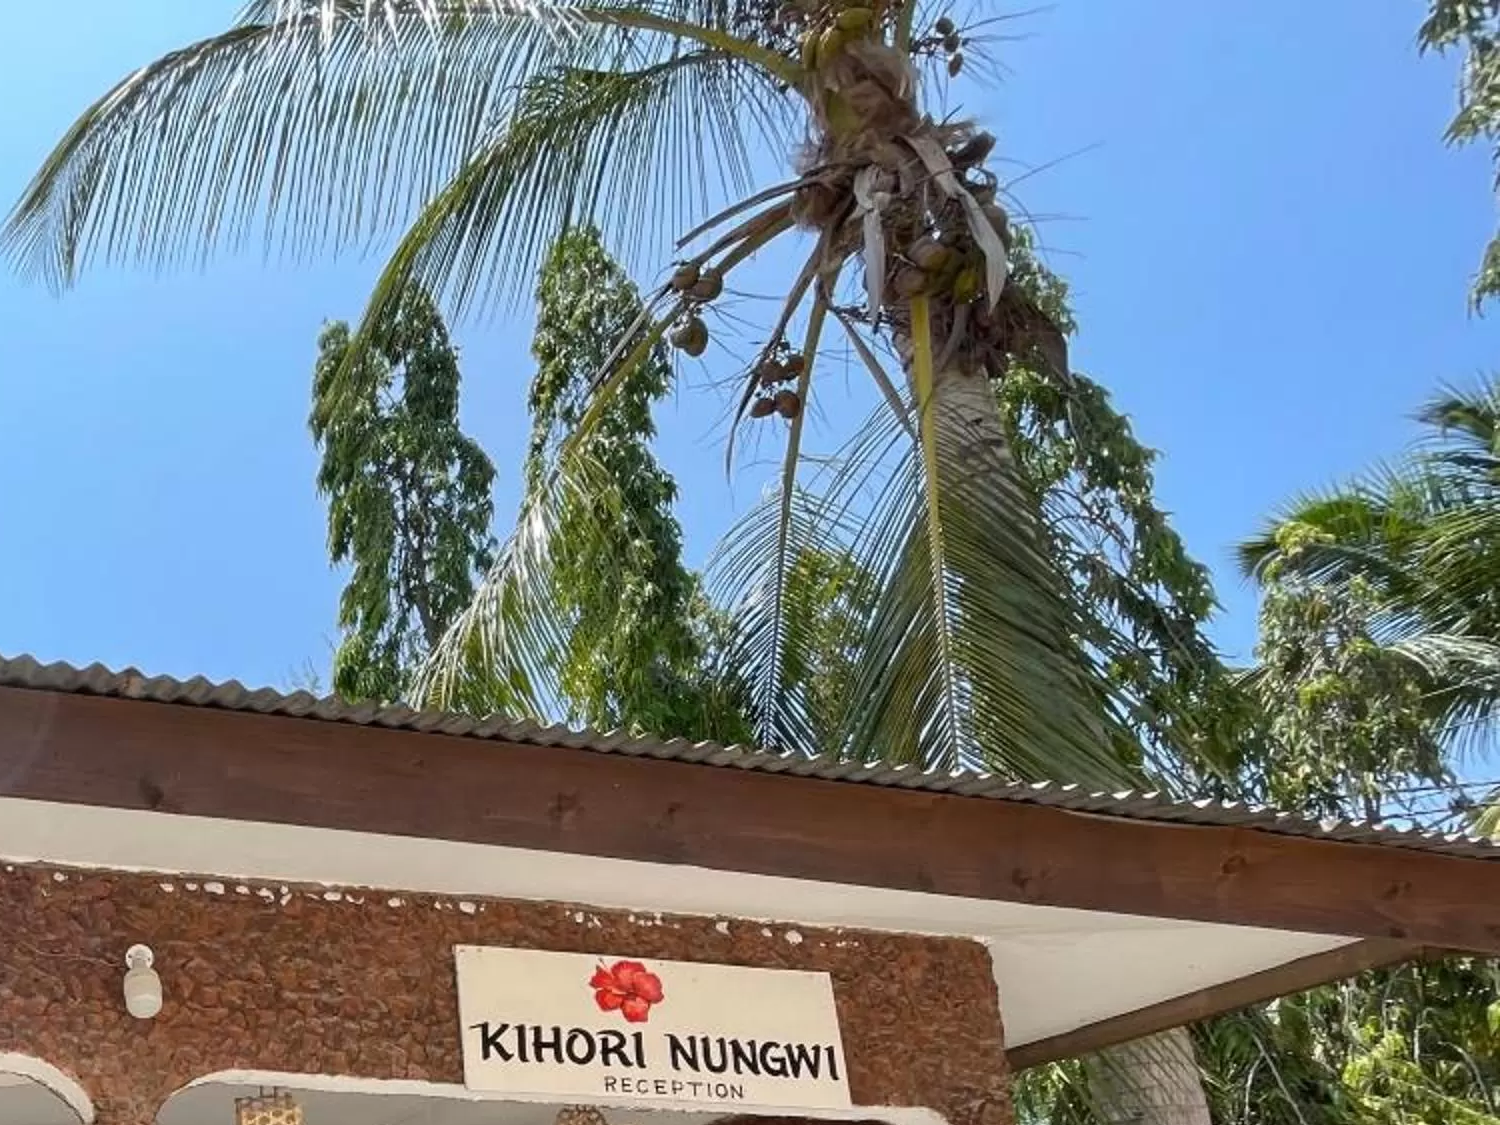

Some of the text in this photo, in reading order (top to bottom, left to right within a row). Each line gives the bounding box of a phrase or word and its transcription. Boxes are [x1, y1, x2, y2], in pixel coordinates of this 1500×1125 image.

[470, 1022, 840, 1081] KIHORI NUNGWI
[604, 1076, 744, 1100] RECEPTION
